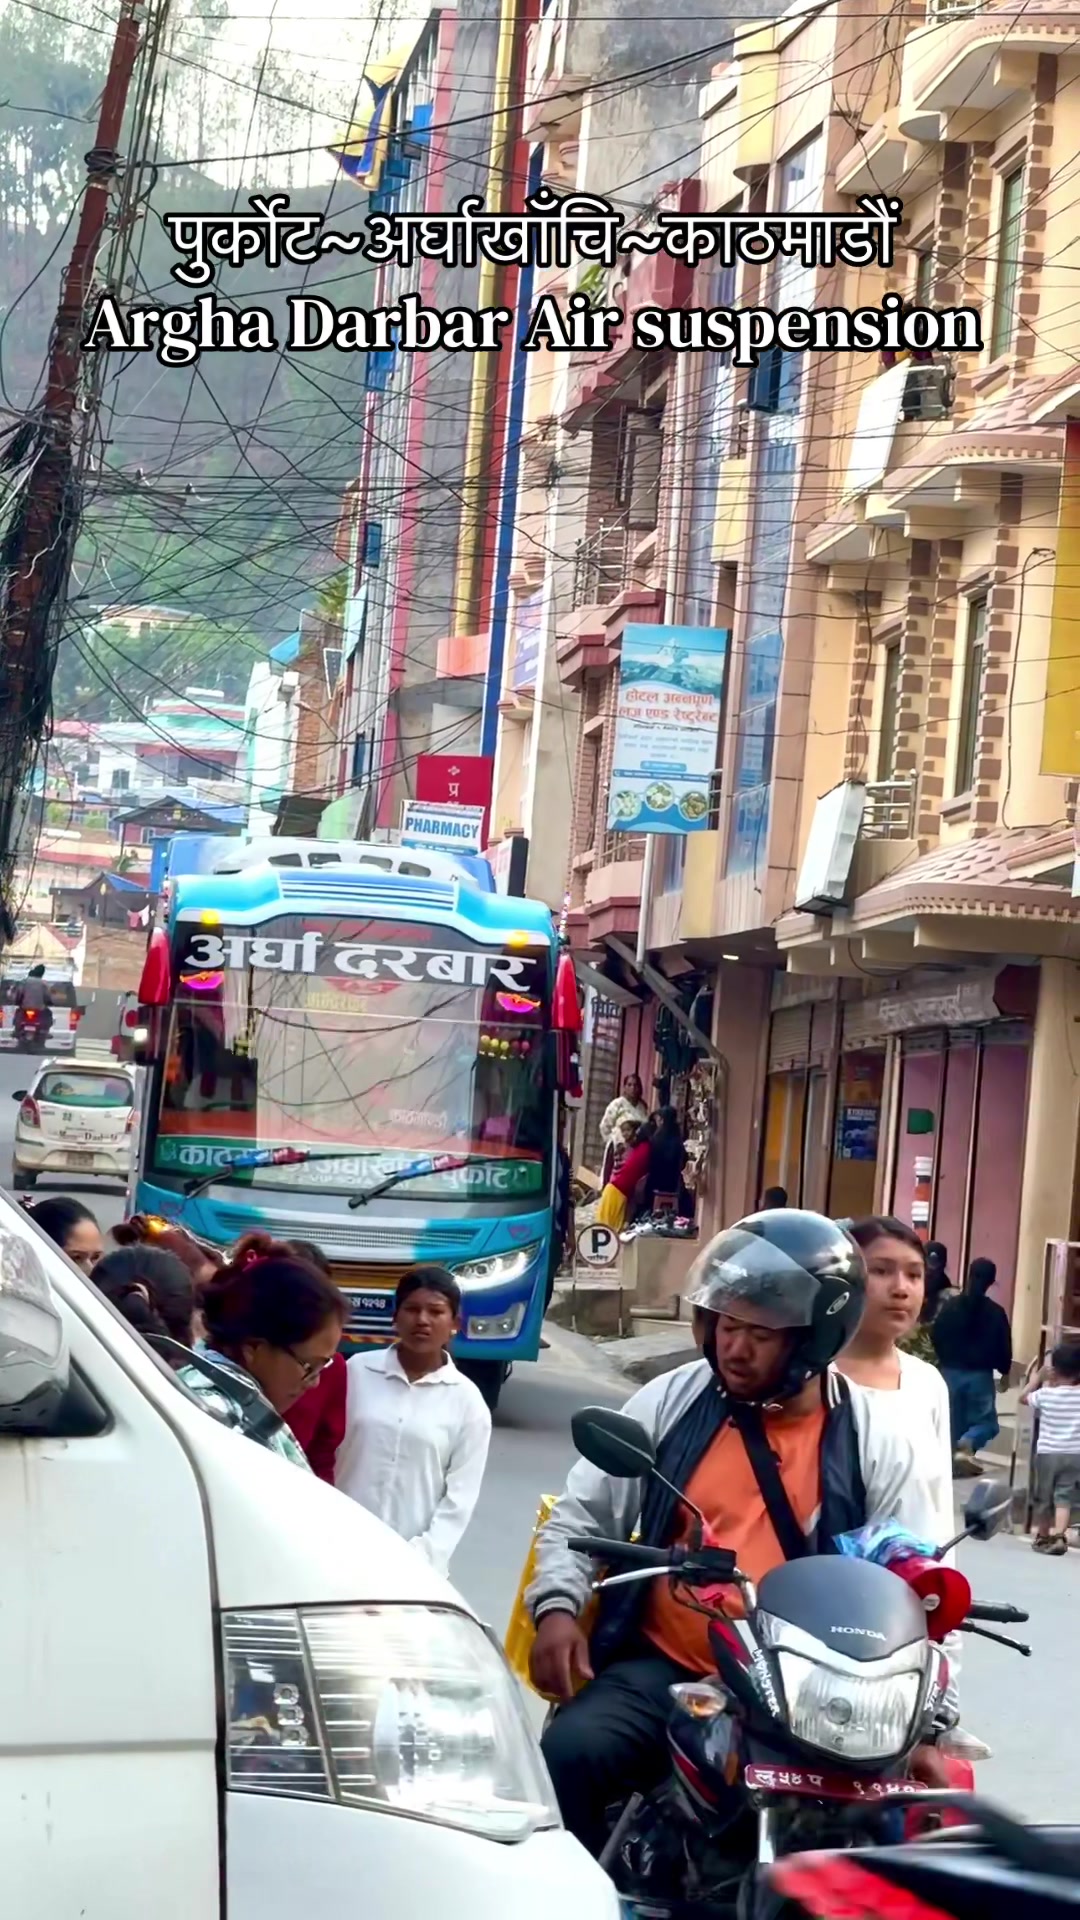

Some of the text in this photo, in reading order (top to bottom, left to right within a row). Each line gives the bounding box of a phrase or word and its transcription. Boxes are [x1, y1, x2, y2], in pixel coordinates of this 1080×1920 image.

[404, 817, 480, 839] PHARMACY
[184, 931, 537, 993] अर्घा दरबार
[592, 1228, 611, 1253] P
[830, 1625, 887, 1641] HONDA
